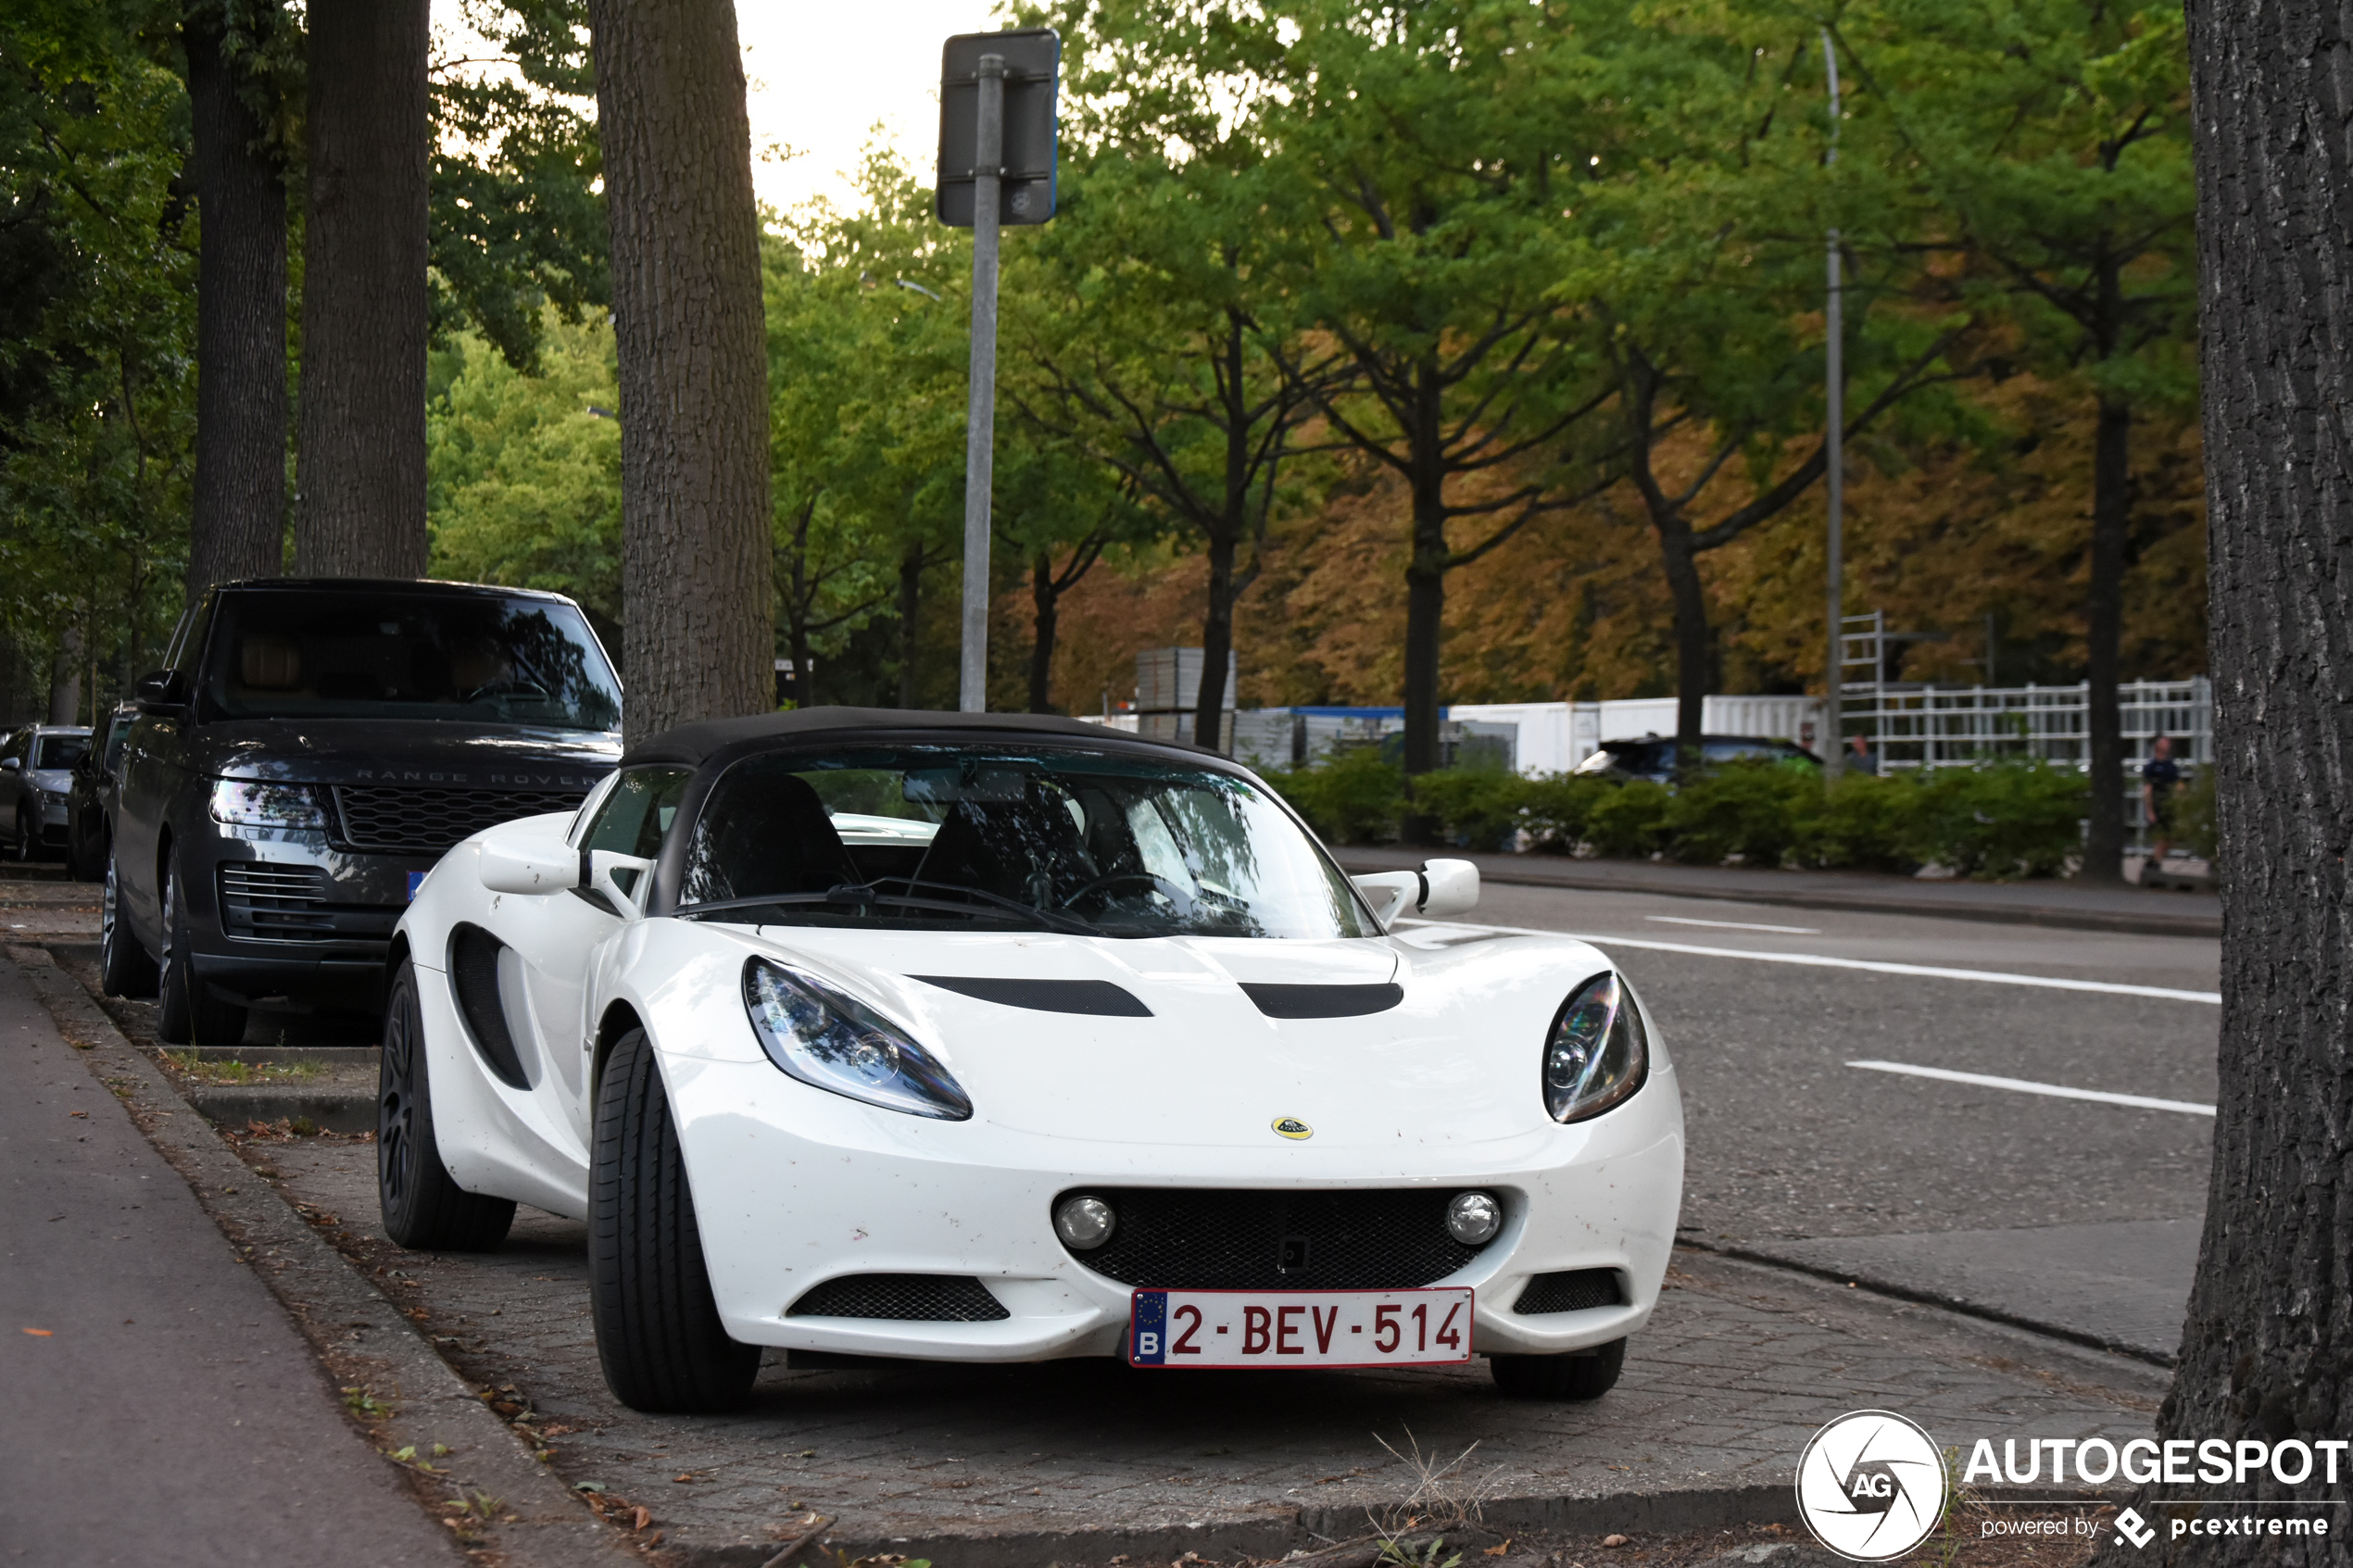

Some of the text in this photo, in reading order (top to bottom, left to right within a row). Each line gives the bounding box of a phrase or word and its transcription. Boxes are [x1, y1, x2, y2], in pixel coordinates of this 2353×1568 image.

[358, 770, 596, 784] RANGE ROVER
[1172, 1302, 1464, 1355] 2-BEV-514
[1139, 1332, 1158, 1354] B
